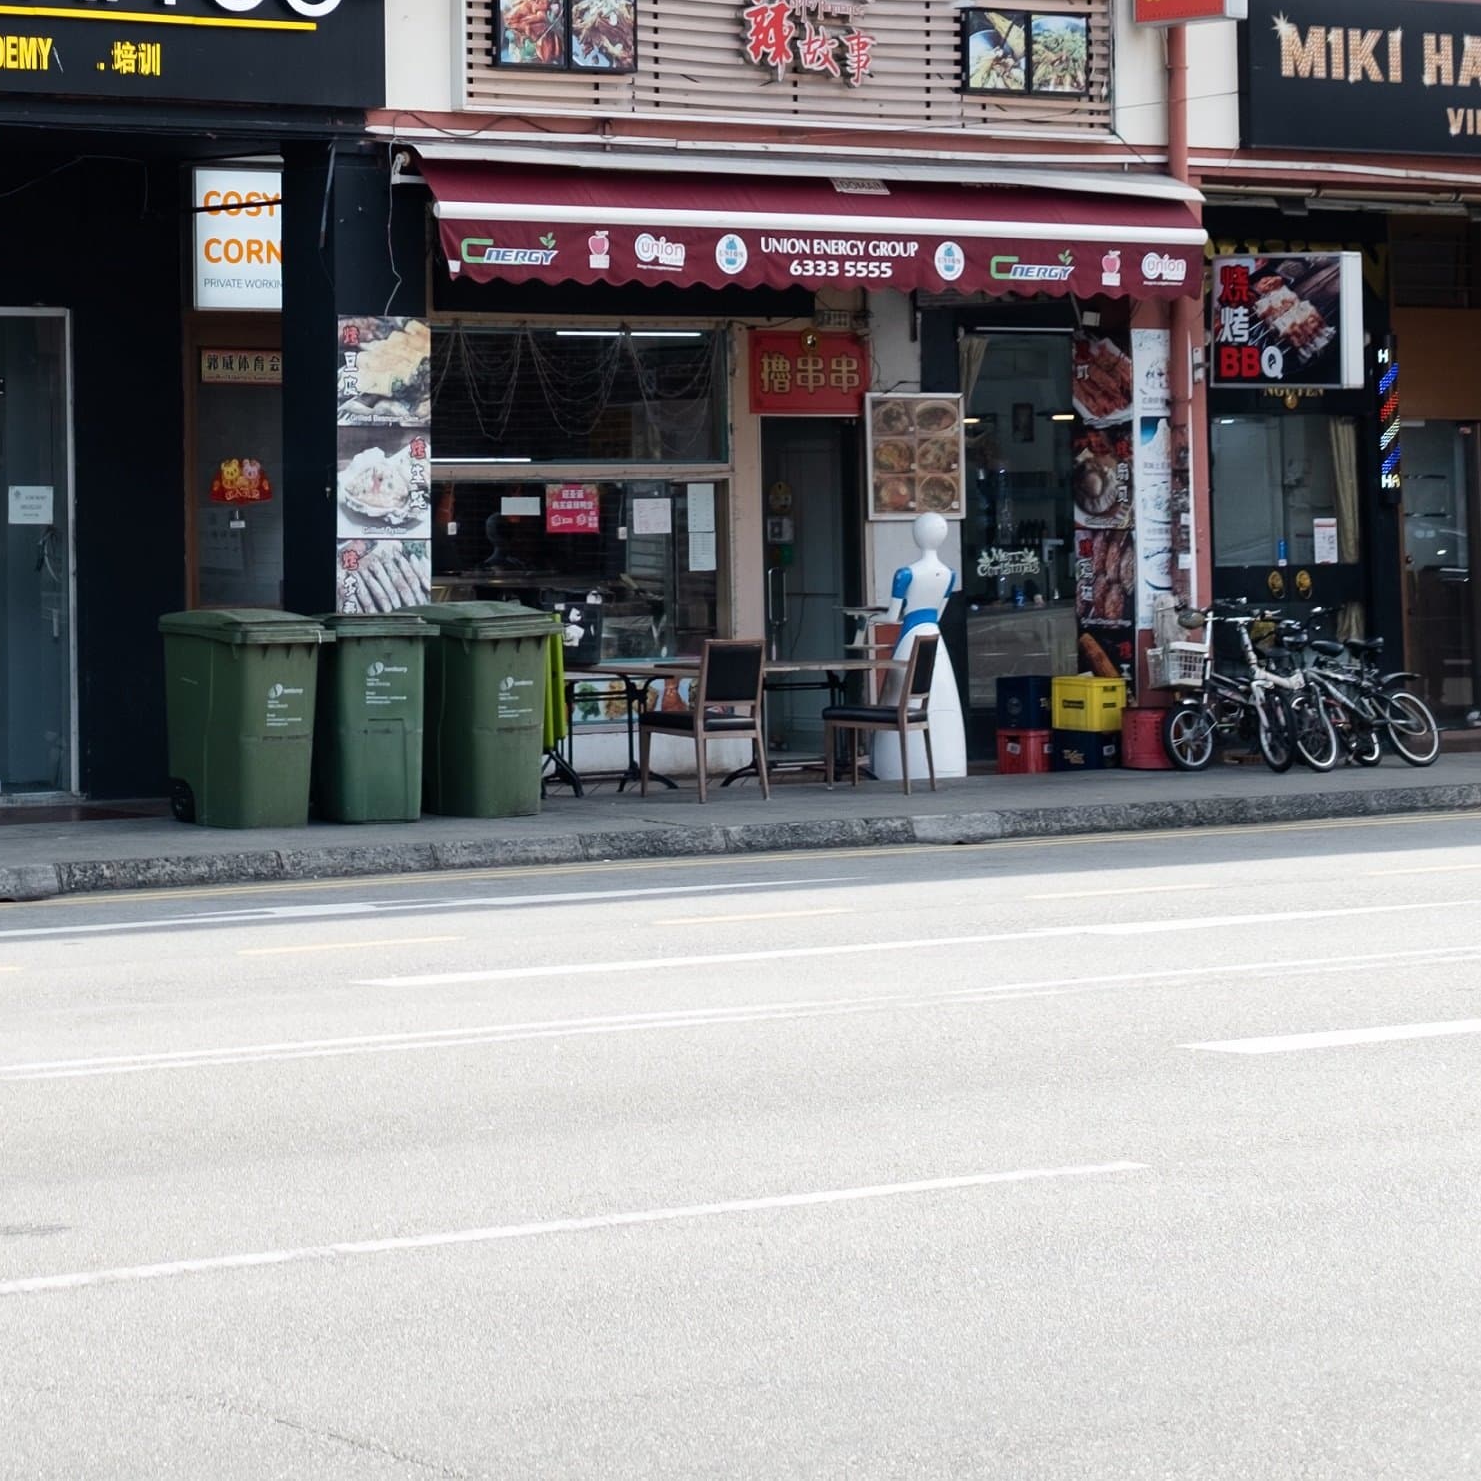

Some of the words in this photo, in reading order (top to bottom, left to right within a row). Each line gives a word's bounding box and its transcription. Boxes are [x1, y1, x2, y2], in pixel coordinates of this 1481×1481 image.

[111, 41, 162, 77] 培训
[1446, 107, 1481, 136] VI
[203, 190, 281, 217] COSY
[760, 236, 811, 255] UNION
[813, 239, 866, 257] ENERGY
[868, 241, 919, 258] GROUP
[789, 259, 840, 277] 6333
[844, 261, 893, 278] 5555
[203, 277, 243, 289] PRIVATE
[1221, 265, 1251, 343] 烧烤
[1220, 345, 1284, 380] BBQ
